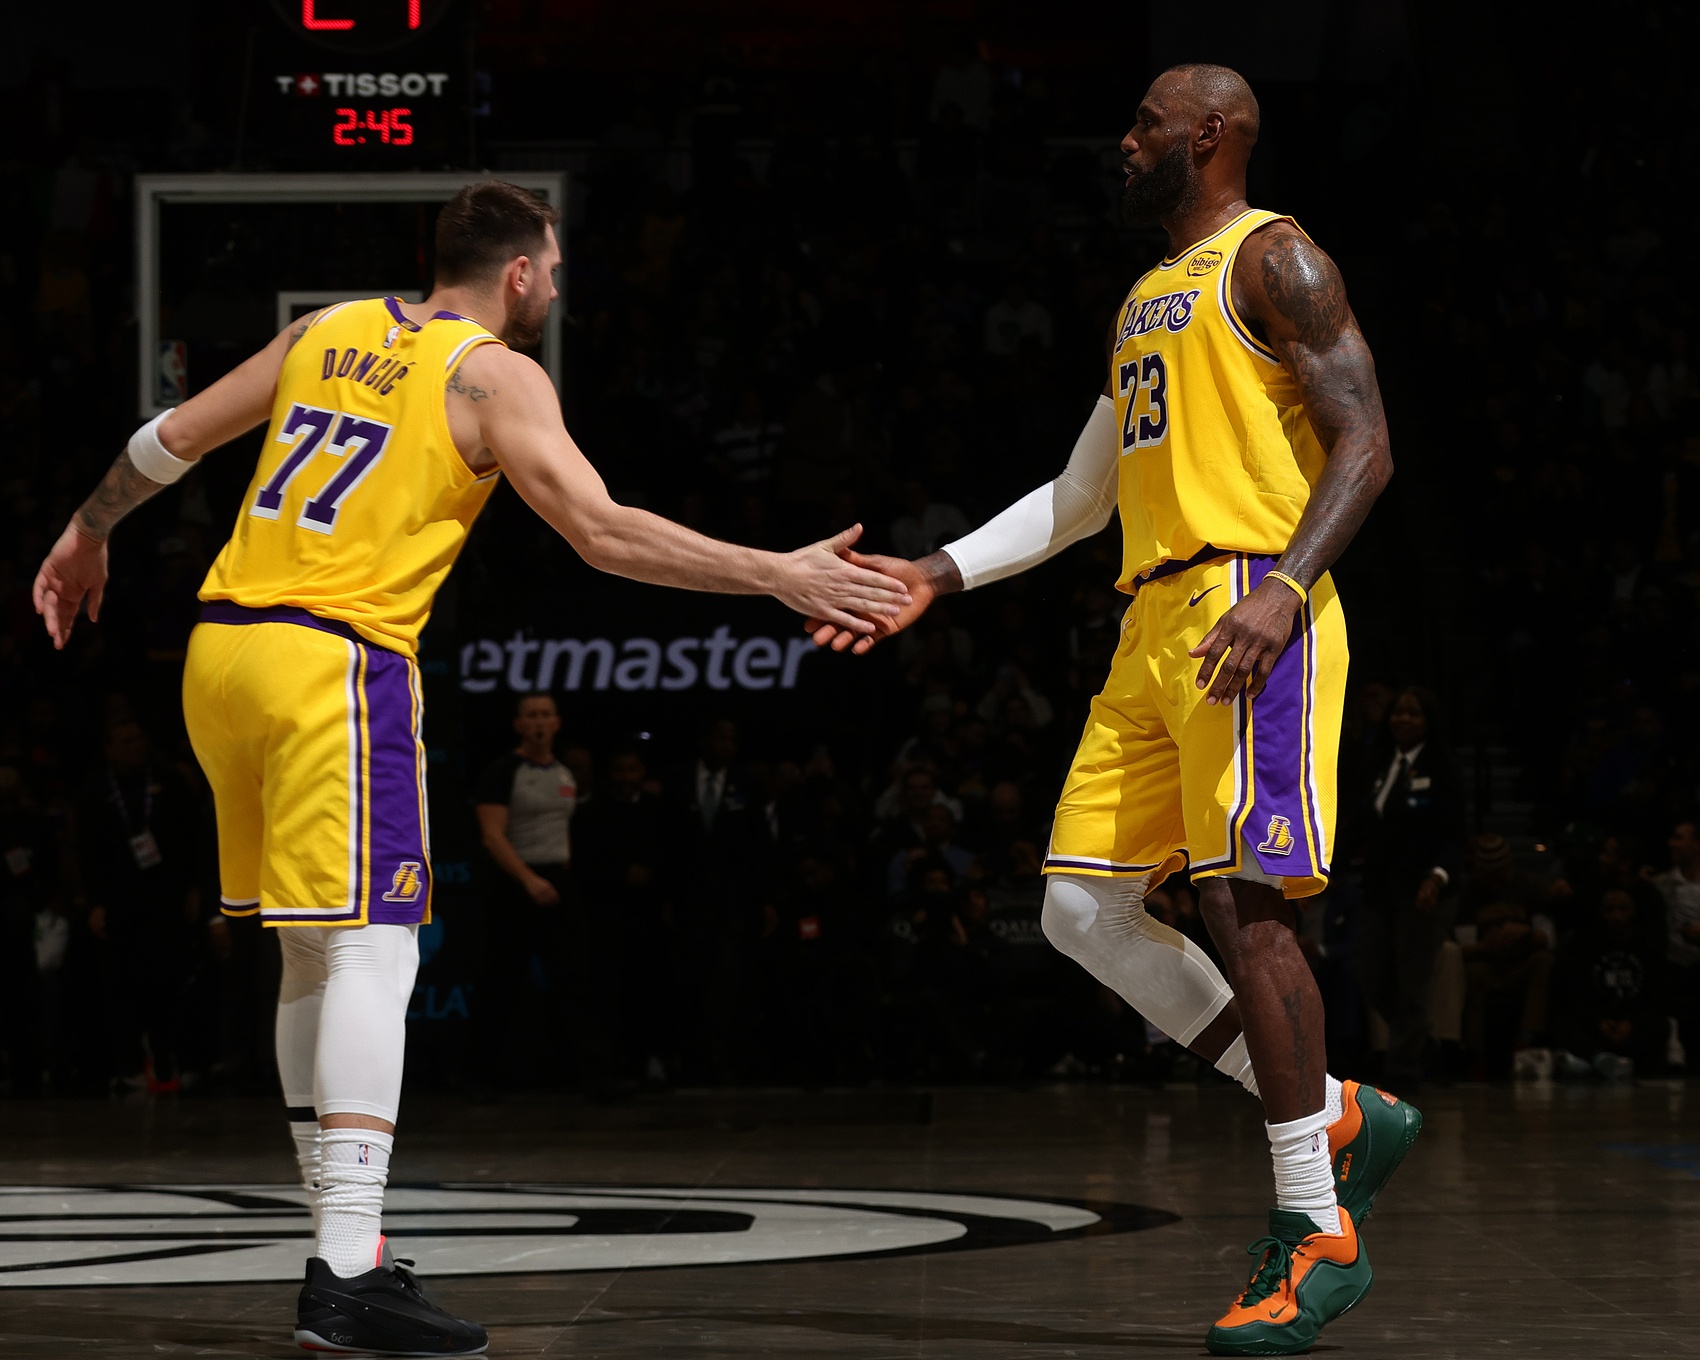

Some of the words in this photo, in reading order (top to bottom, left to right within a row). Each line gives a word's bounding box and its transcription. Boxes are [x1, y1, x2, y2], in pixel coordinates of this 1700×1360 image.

[322, 72, 449, 98] TISSOT
[331, 107, 415, 147] 2:45
[1191, 257, 1219, 269] bibigo
[1115, 289, 1202, 355] LAKERS
[1118, 352, 1168, 456] 23
[249, 402, 395, 536] 77
[459, 624, 818, 693] etmaster
